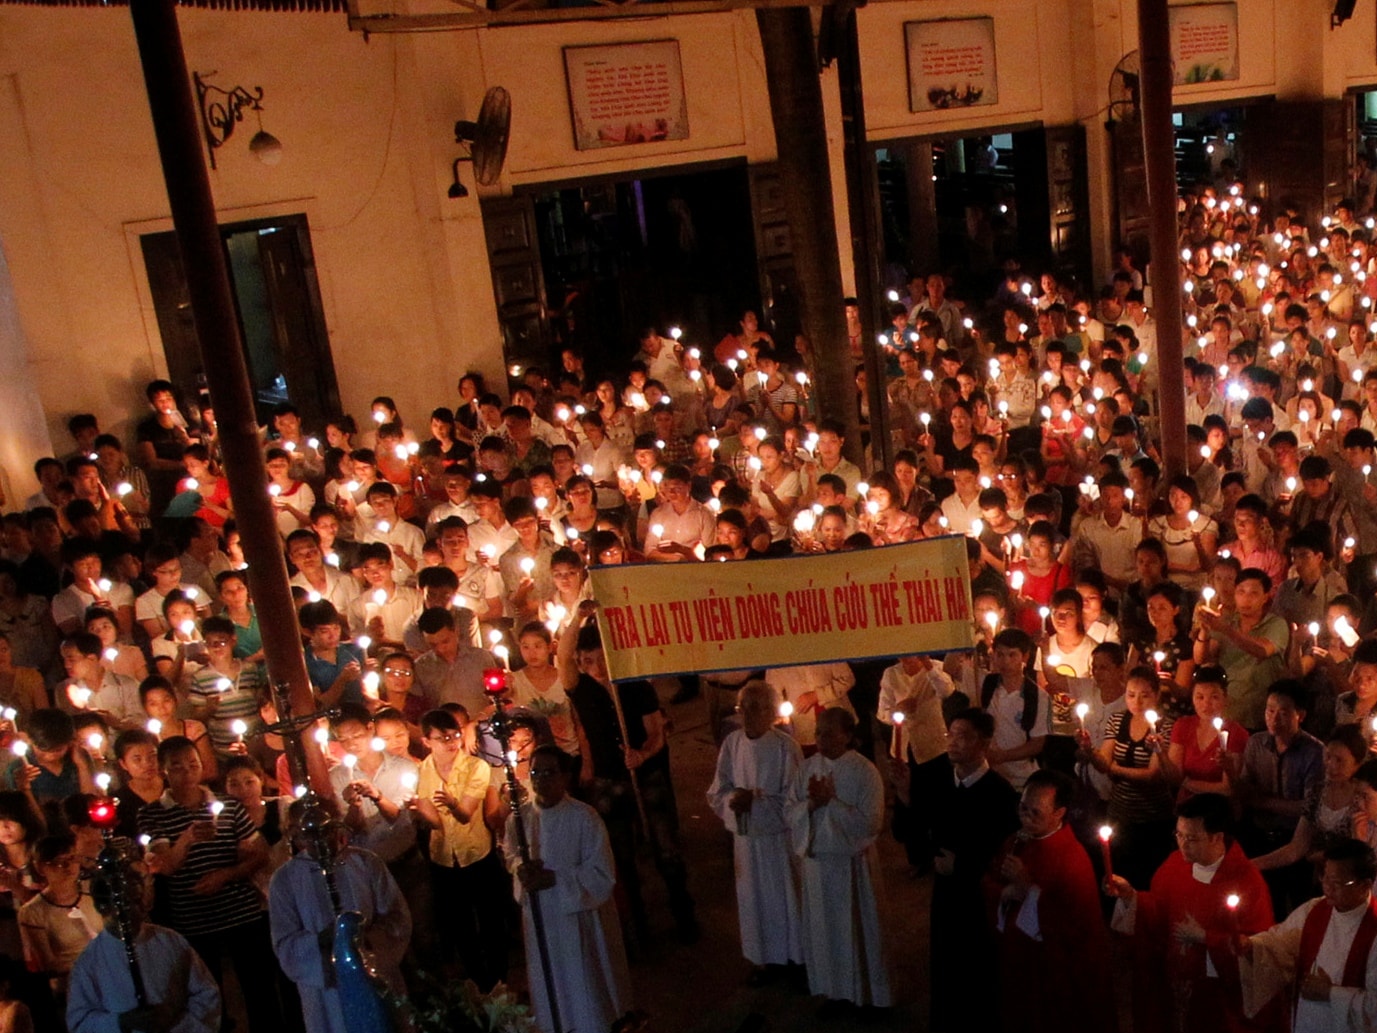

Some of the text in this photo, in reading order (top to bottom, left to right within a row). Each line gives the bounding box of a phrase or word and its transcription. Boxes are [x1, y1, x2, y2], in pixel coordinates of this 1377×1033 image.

[604, 564, 968, 656] TRẢ LẠI TU VIỆN DÒNG CHÚA CỨU THẾ THÁI HÀ
